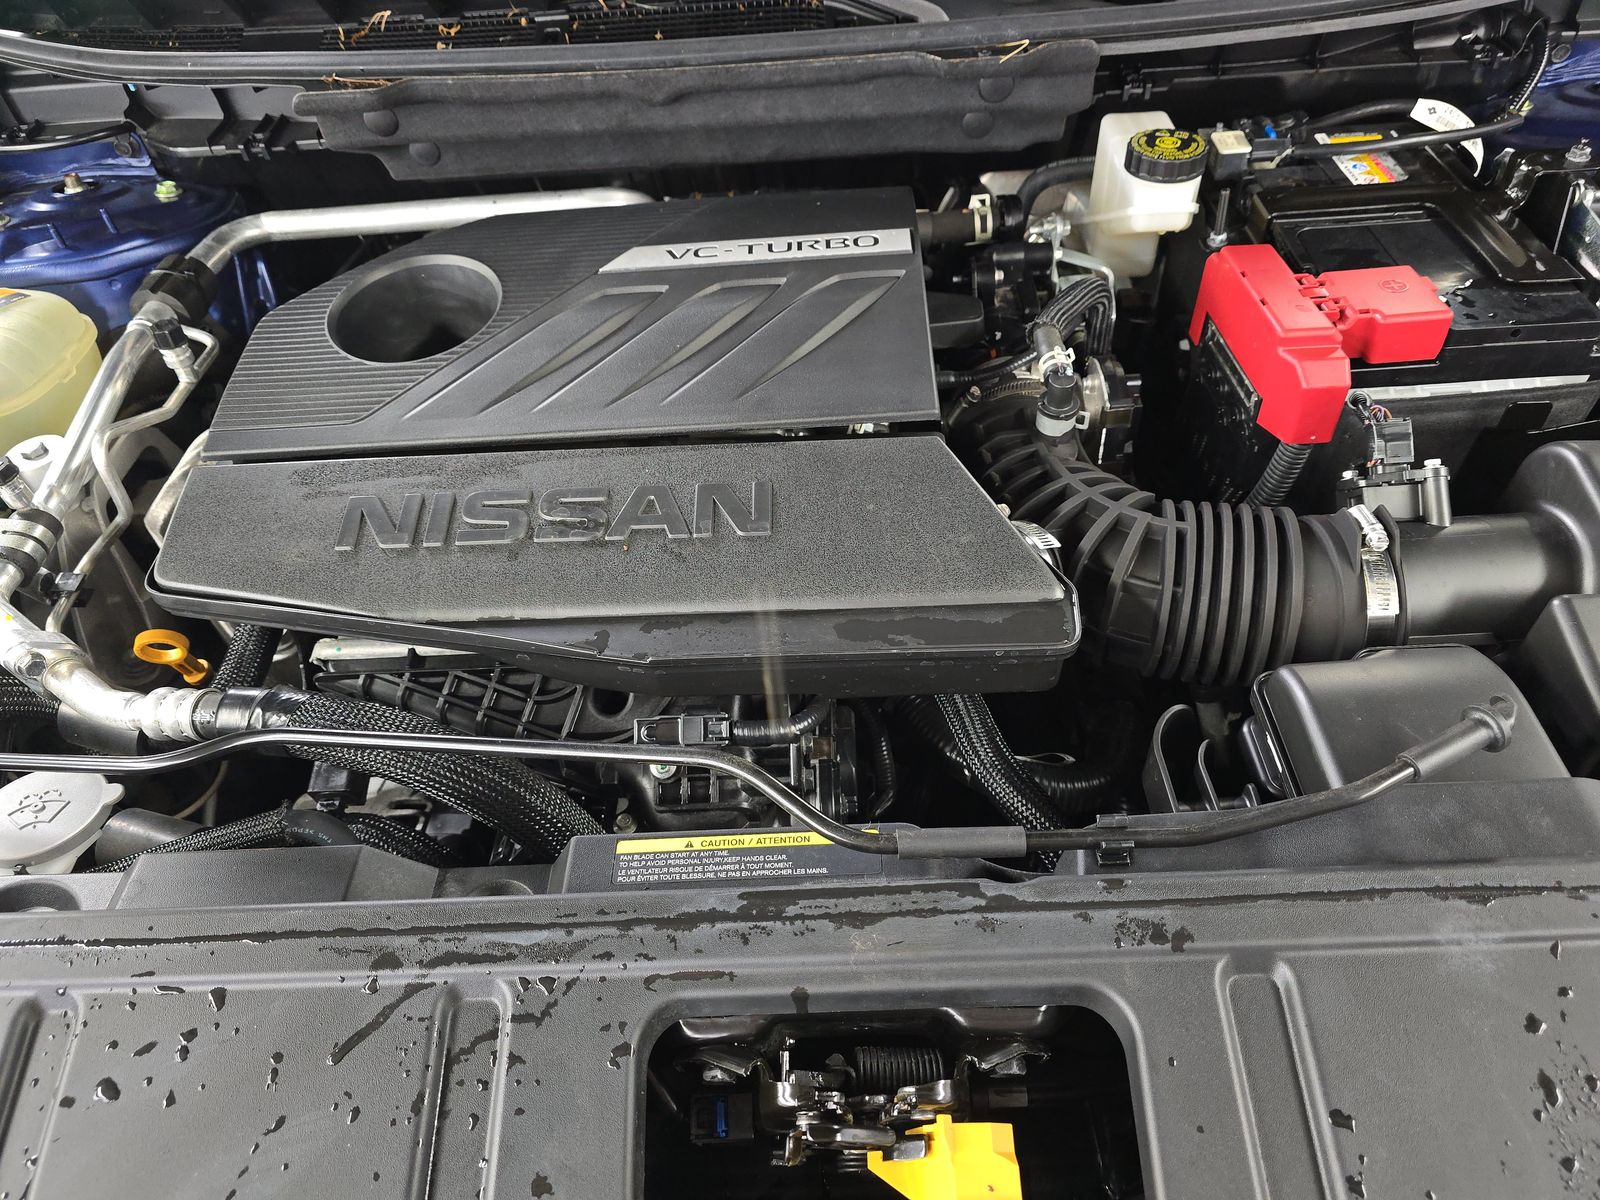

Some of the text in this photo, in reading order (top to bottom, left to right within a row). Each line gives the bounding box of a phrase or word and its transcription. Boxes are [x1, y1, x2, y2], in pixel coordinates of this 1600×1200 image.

[665, 234, 880, 260] VC-TURBO
[334, 480, 773, 551] NISSAN
[700, 838, 745, 848] CAUTION
[756, 836, 811, 845] ATTENTION
[629, 860, 646, 868] HELP
[646, 859, 667, 867] AVOID
[667, 857, 701, 866] PERSONAL
[741, 854, 765, 862] HANDS
[633, 853, 655, 861] BLADE
[670, 851, 690, 859] START
[700, 850, 713, 858] ANY
[616, 875, 636, 883] POUR
[636, 873, 659, 882] ÉVITER
[660, 873, 681, 881] TOUTE
[727, 870, 741, 878] PAS
[751, 868, 793, 877] APPROCHER
[806, 867, 829, 875] MAINS.
[627, 867, 669, 875] VENTILATEUR
[669, 865, 694, 874] RISQUE
[704, 863, 740, 872] DÉMARRER
[740, 862, 746, 870] À
[746, 862, 764, 870] TOUT
[764, 861, 794, 869] MOMENT.
